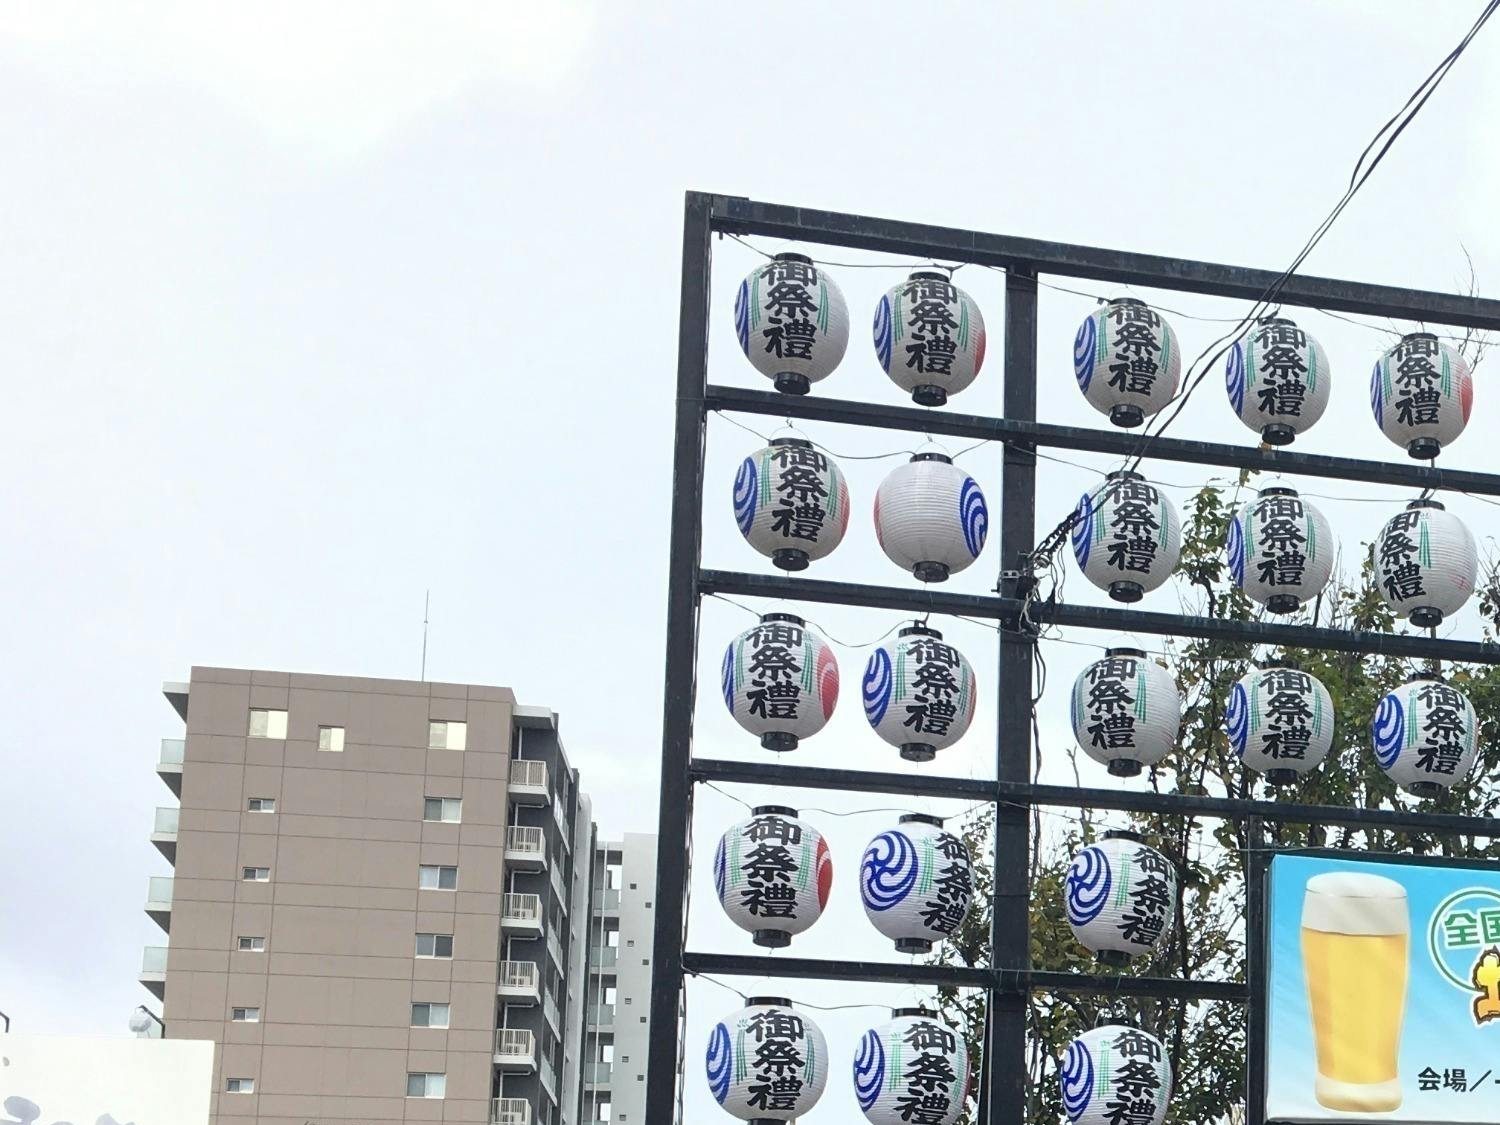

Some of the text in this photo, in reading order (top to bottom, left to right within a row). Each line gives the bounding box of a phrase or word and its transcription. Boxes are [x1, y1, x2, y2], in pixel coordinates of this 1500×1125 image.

[759, 261, 818, 359] 御祭禮
[901, 278, 958, 376] 御祭禮
[1106, 301, 1160, 395] 御祭禮
[1255, 322, 1306, 417] 御祭禮
[1391, 336, 1441, 426] 御祭禮
[771, 446, 828, 542] 御祭禮
[1104, 478, 1158, 574] 御祭禮
[1253, 496, 1306, 586] 御祭禮
[744, 623, 803, 720] 御祭禮
[902, 636, 960, 737] 御祭禮
[1083, 657, 1136, 749] 御祭禮
[1258, 669, 1311, 759] 御祭禮
[1413, 683, 1465, 774] 御祭禮
[740, 814, 801, 919] 御祭禮
[918, 830, 972, 935] 御祭禮
[1117, 844, 1176, 943] 御祭禮
[746, 1008, 805, 1112] 御祭禮
